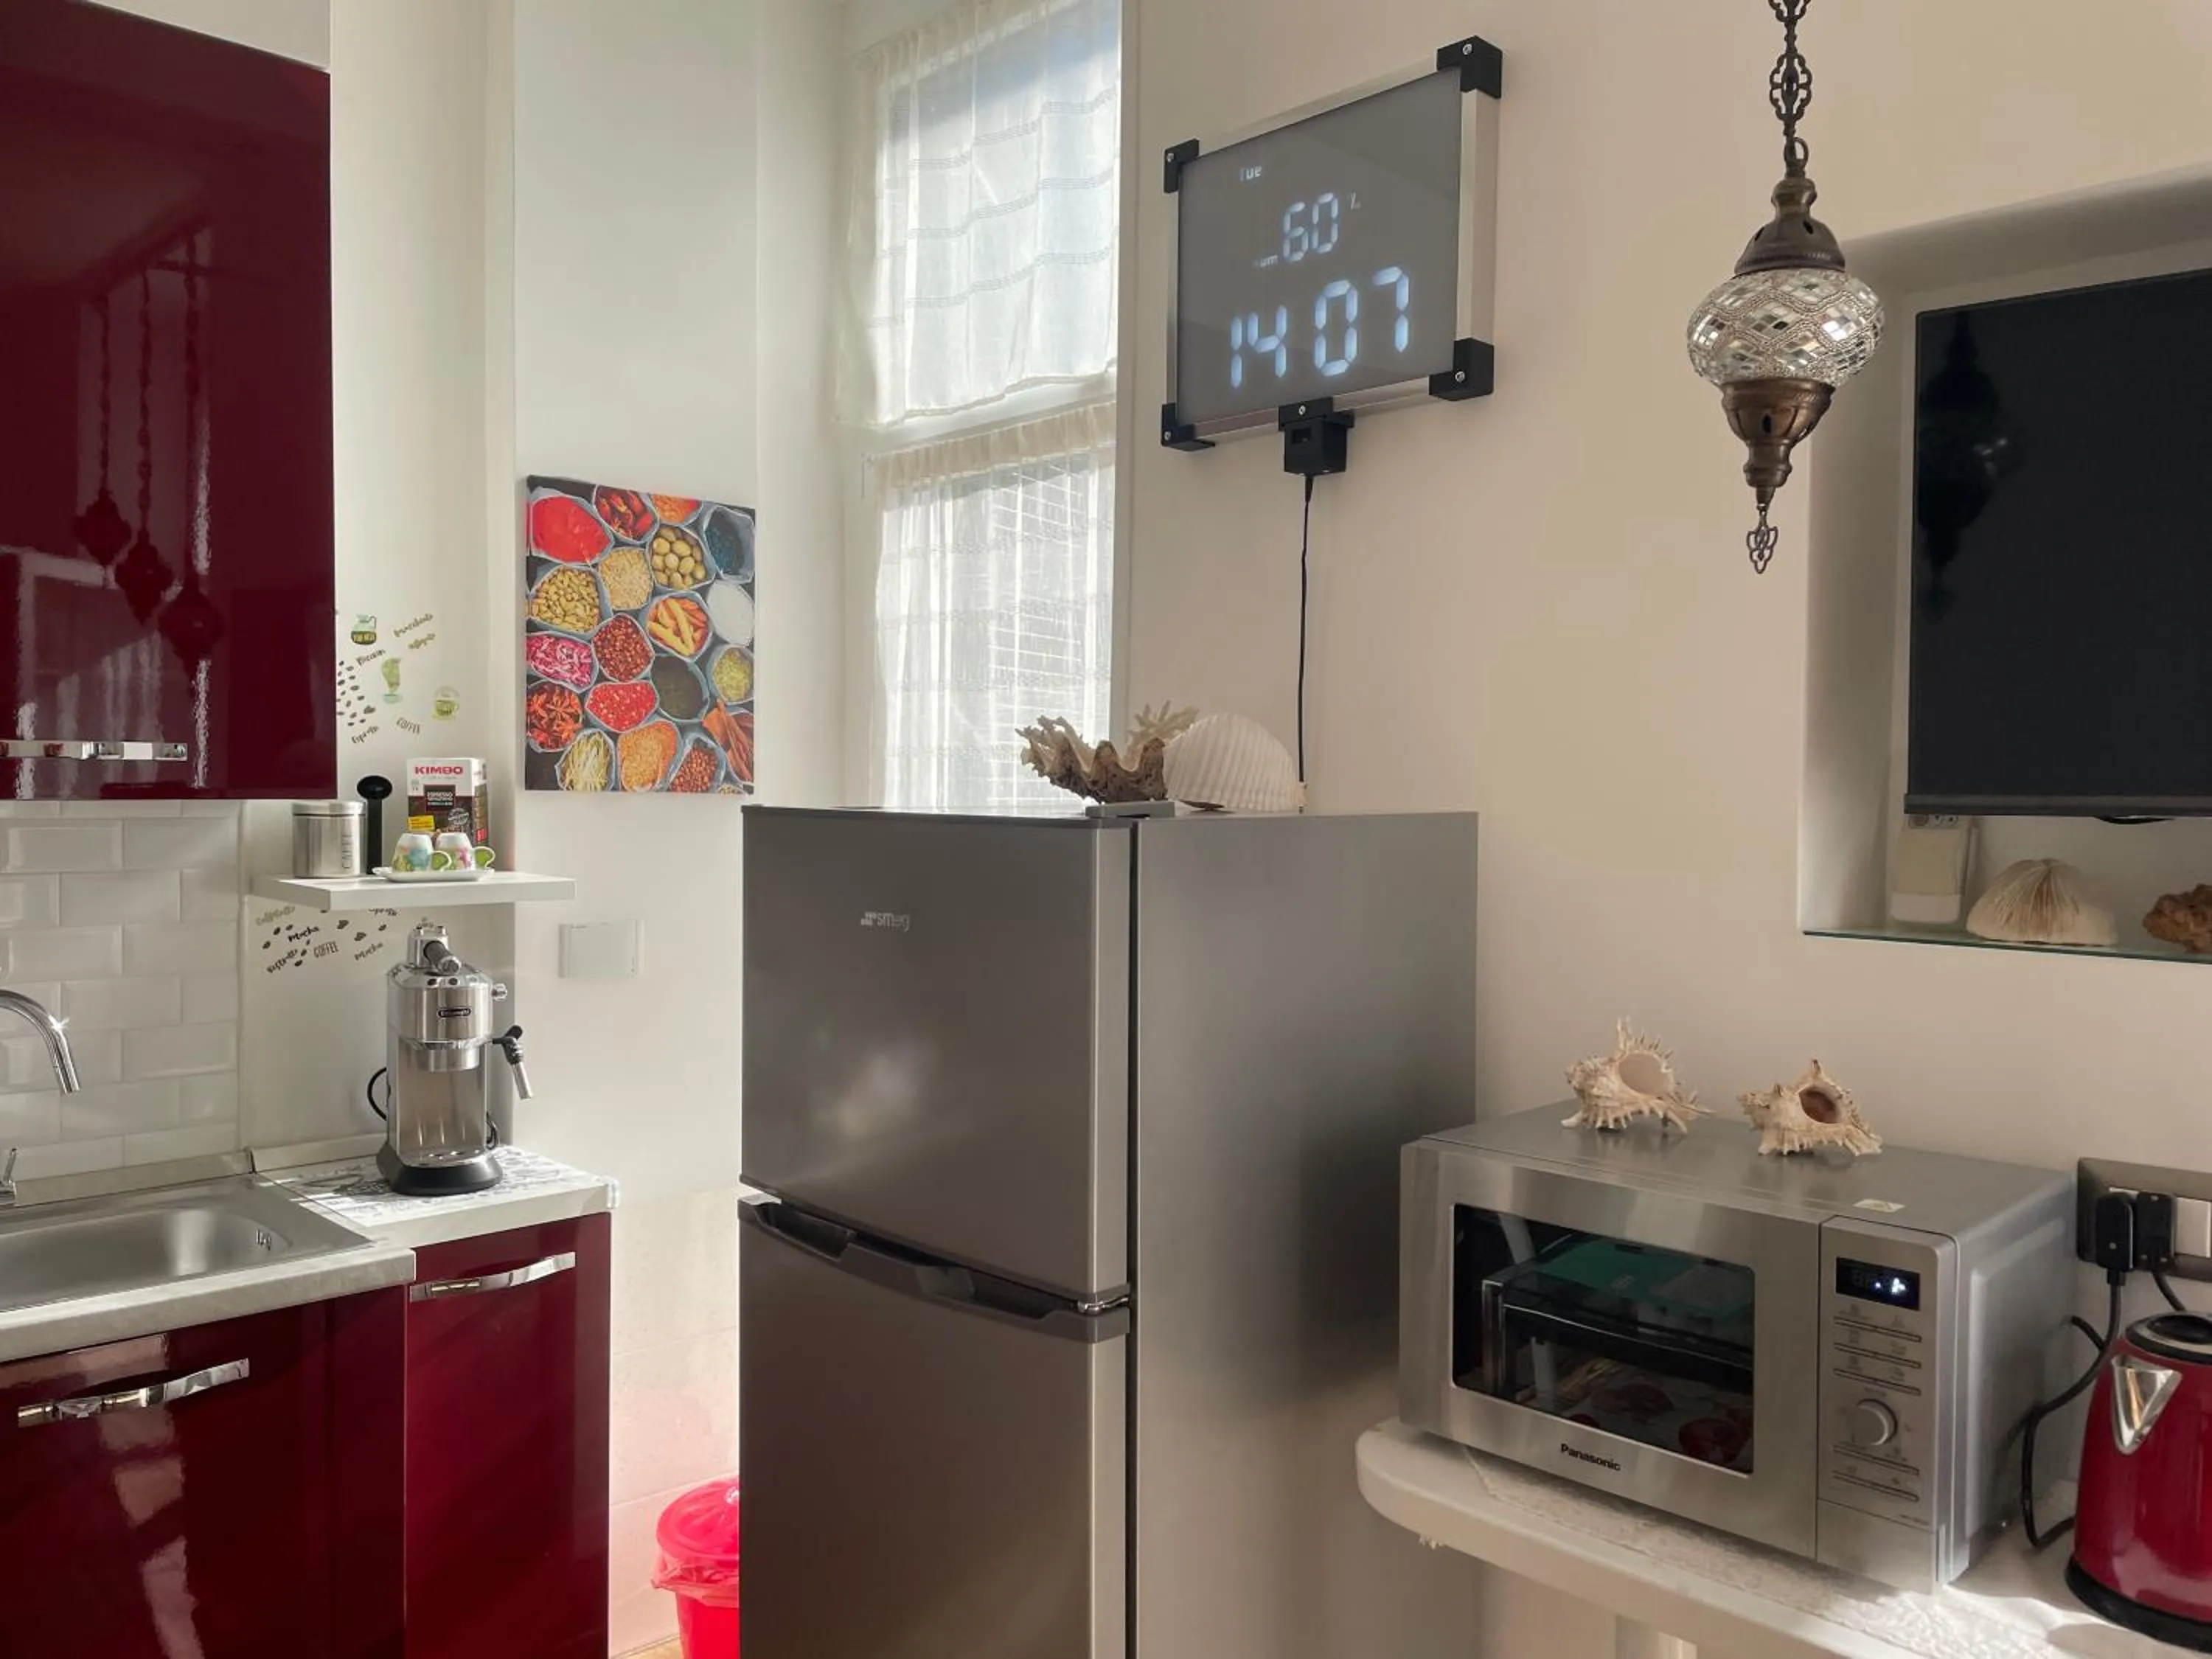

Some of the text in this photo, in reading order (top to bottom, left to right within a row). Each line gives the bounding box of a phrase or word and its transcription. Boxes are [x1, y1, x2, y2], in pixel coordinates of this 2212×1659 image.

[1283, 192, 1339, 262] 60
[414, 766, 464, 775] KIMBO
[313, 941, 339, 959] COFFEE
[1560, 1443, 1621, 1472] Panasonic
